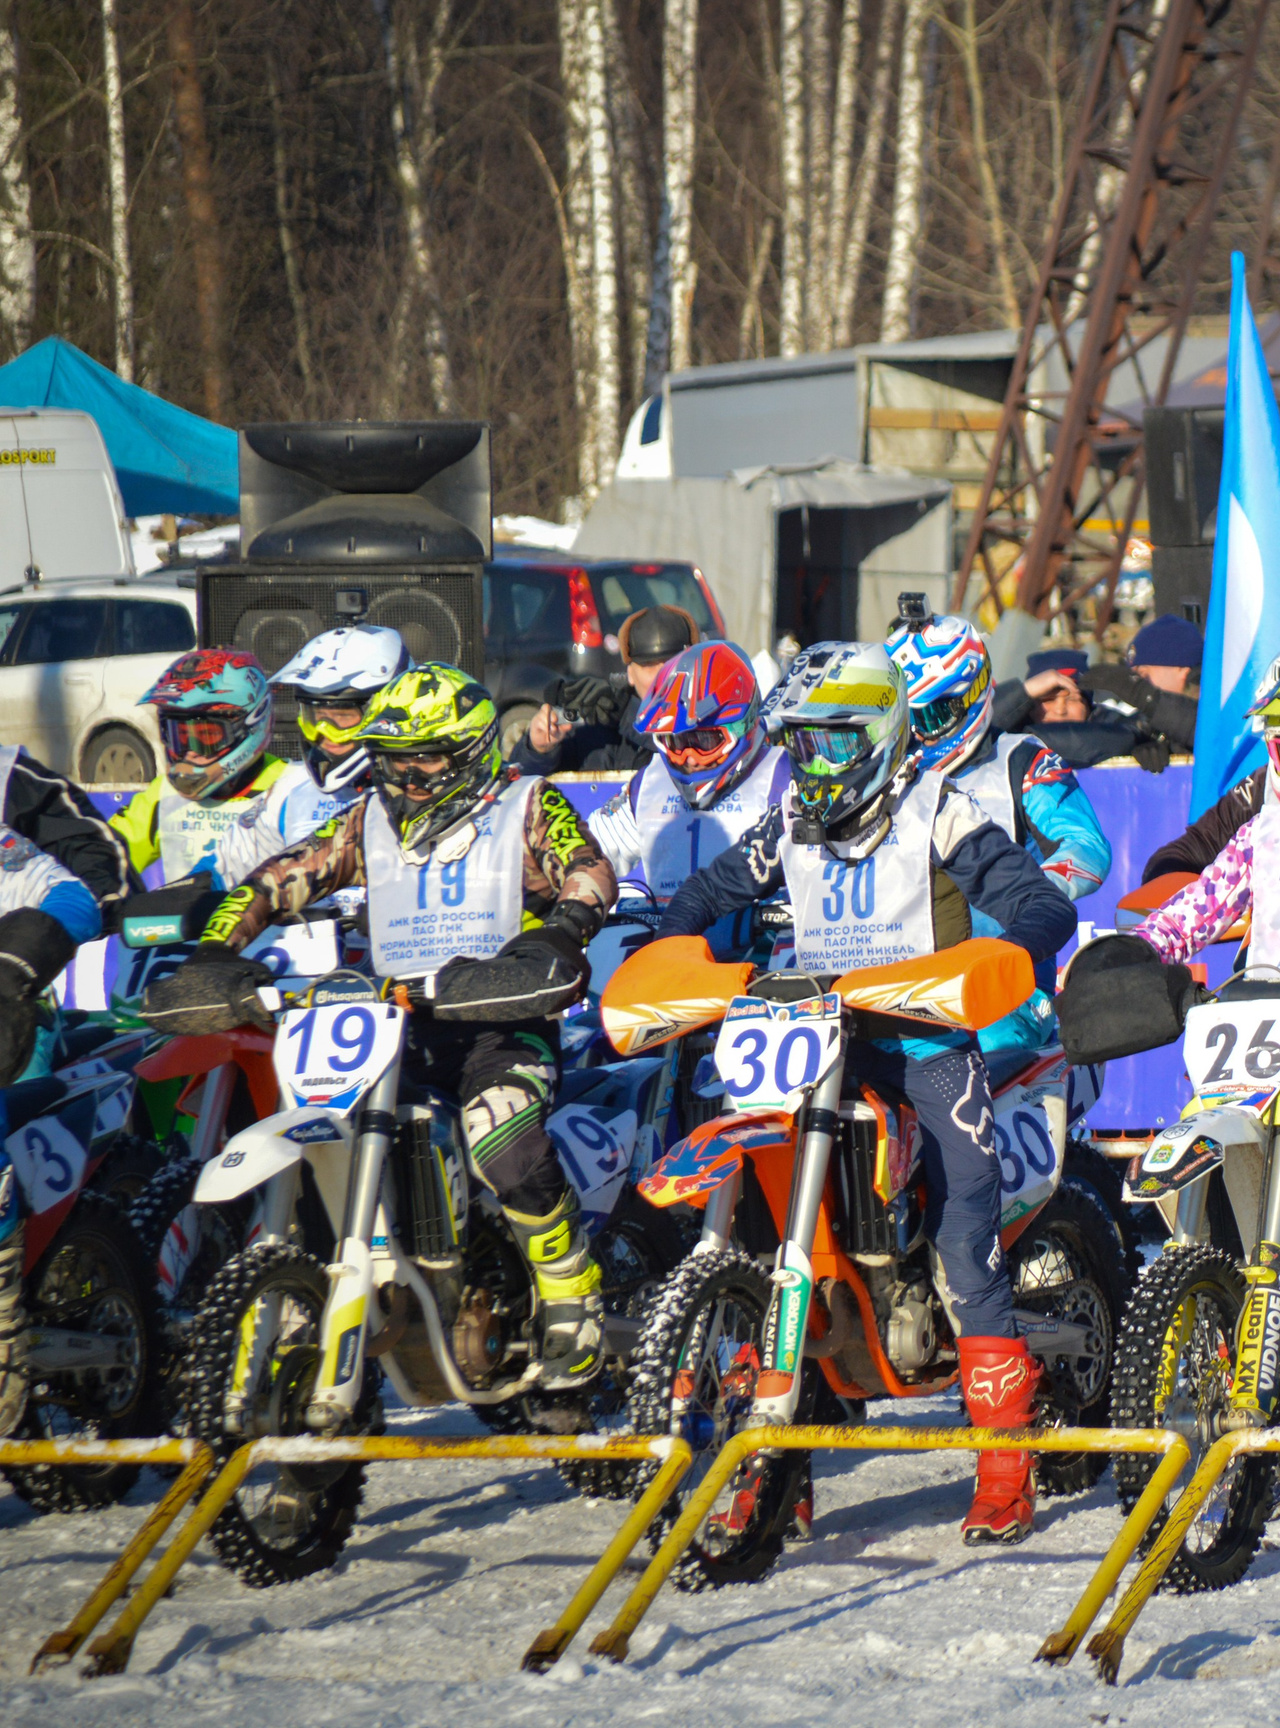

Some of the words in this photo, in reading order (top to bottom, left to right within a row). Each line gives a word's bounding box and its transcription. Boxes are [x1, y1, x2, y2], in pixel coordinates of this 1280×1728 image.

[0, 447, 56, 465] OSPORT
[186, 809, 240, 822] МОТОКР
[417, 855, 467, 911] 19
[822, 855, 877, 923] 30
[412, 914, 438, 926] ФСО
[442, 911, 496, 923] РОССИИ
[129, 924, 178, 937] VIPER
[411, 925, 437, 936] ПАО
[439, 923, 463, 934] ГМК
[824, 925, 851, 937] ФСО
[853, 922, 903, 935] РОССИИ
[379, 932, 454, 952] НОРИЛЬСКИЙ
[457, 933, 506, 945] НИКЕЛЬ
[824, 936, 848, 948] ПАО
[850, 935, 873, 945] ГМК
[866, 944, 916, 957] НИКЕЛЬ
[803, 960, 827, 971] СПАО
[327, 990, 376, 1001] Husqvarna
[286, 1006, 377, 1075] 19
[724, 1026, 822, 1098] 30
[1219, 1084, 1245, 1094] riders
[1246, 1085, 1274, 1094] group
[785, 1289, 802, 1351] MOTOREX
[1241, 1292, 1265, 1354] Team
[1236, 1359, 1257, 1395] MX
